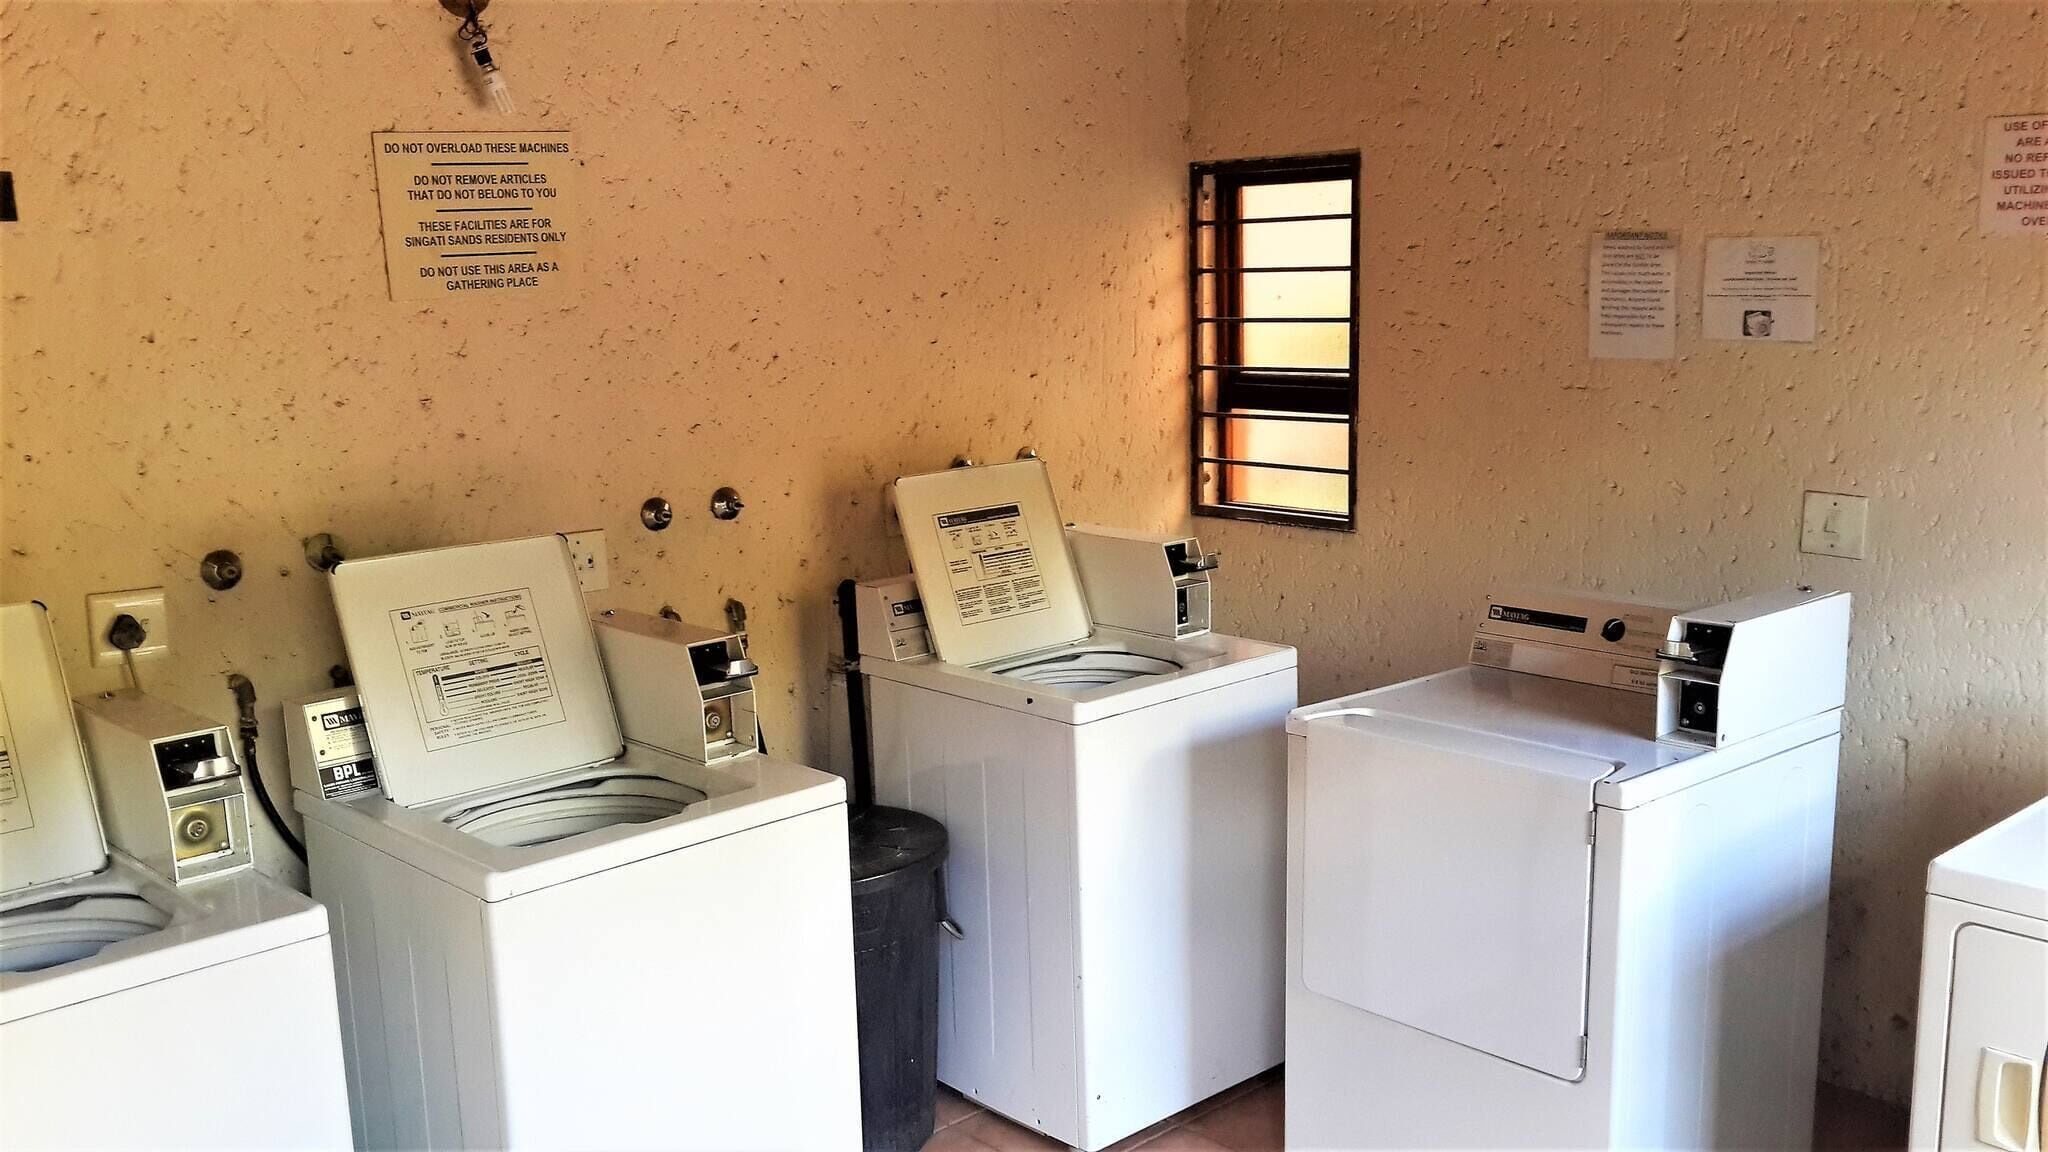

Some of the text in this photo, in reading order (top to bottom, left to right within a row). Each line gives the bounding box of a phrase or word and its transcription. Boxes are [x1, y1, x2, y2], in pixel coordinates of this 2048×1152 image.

[2004, 121, 2048, 131] USE OF
[2016, 137, 2041, 147] ARE
[384, 143, 569, 153] DO NOT OVERLOAD THESE MACHINES
[2005, 153, 2022, 163] NO
[1992, 169, 2048, 179] ISSUED T
[414, 174, 546, 186] DO NOT REMOVE ARTICLES
[408, 188, 556, 200] THAT DO NOT BELONG TO YOU
[419, 219, 551, 232] THESE FACILITIES ARE FOR
[405, 232, 566, 247] SINGATI SANDS RESIDENTS ONLY
[420, 262, 559, 277] DO NOT USE THIS AREA AS A
[447, 277, 538, 291] GATHERING PLACE
[514, 649, 529, 657] CYCLE
[416, 665, 450, 676] TEMPERATURE
[333, 763, 361, 781] BPL
